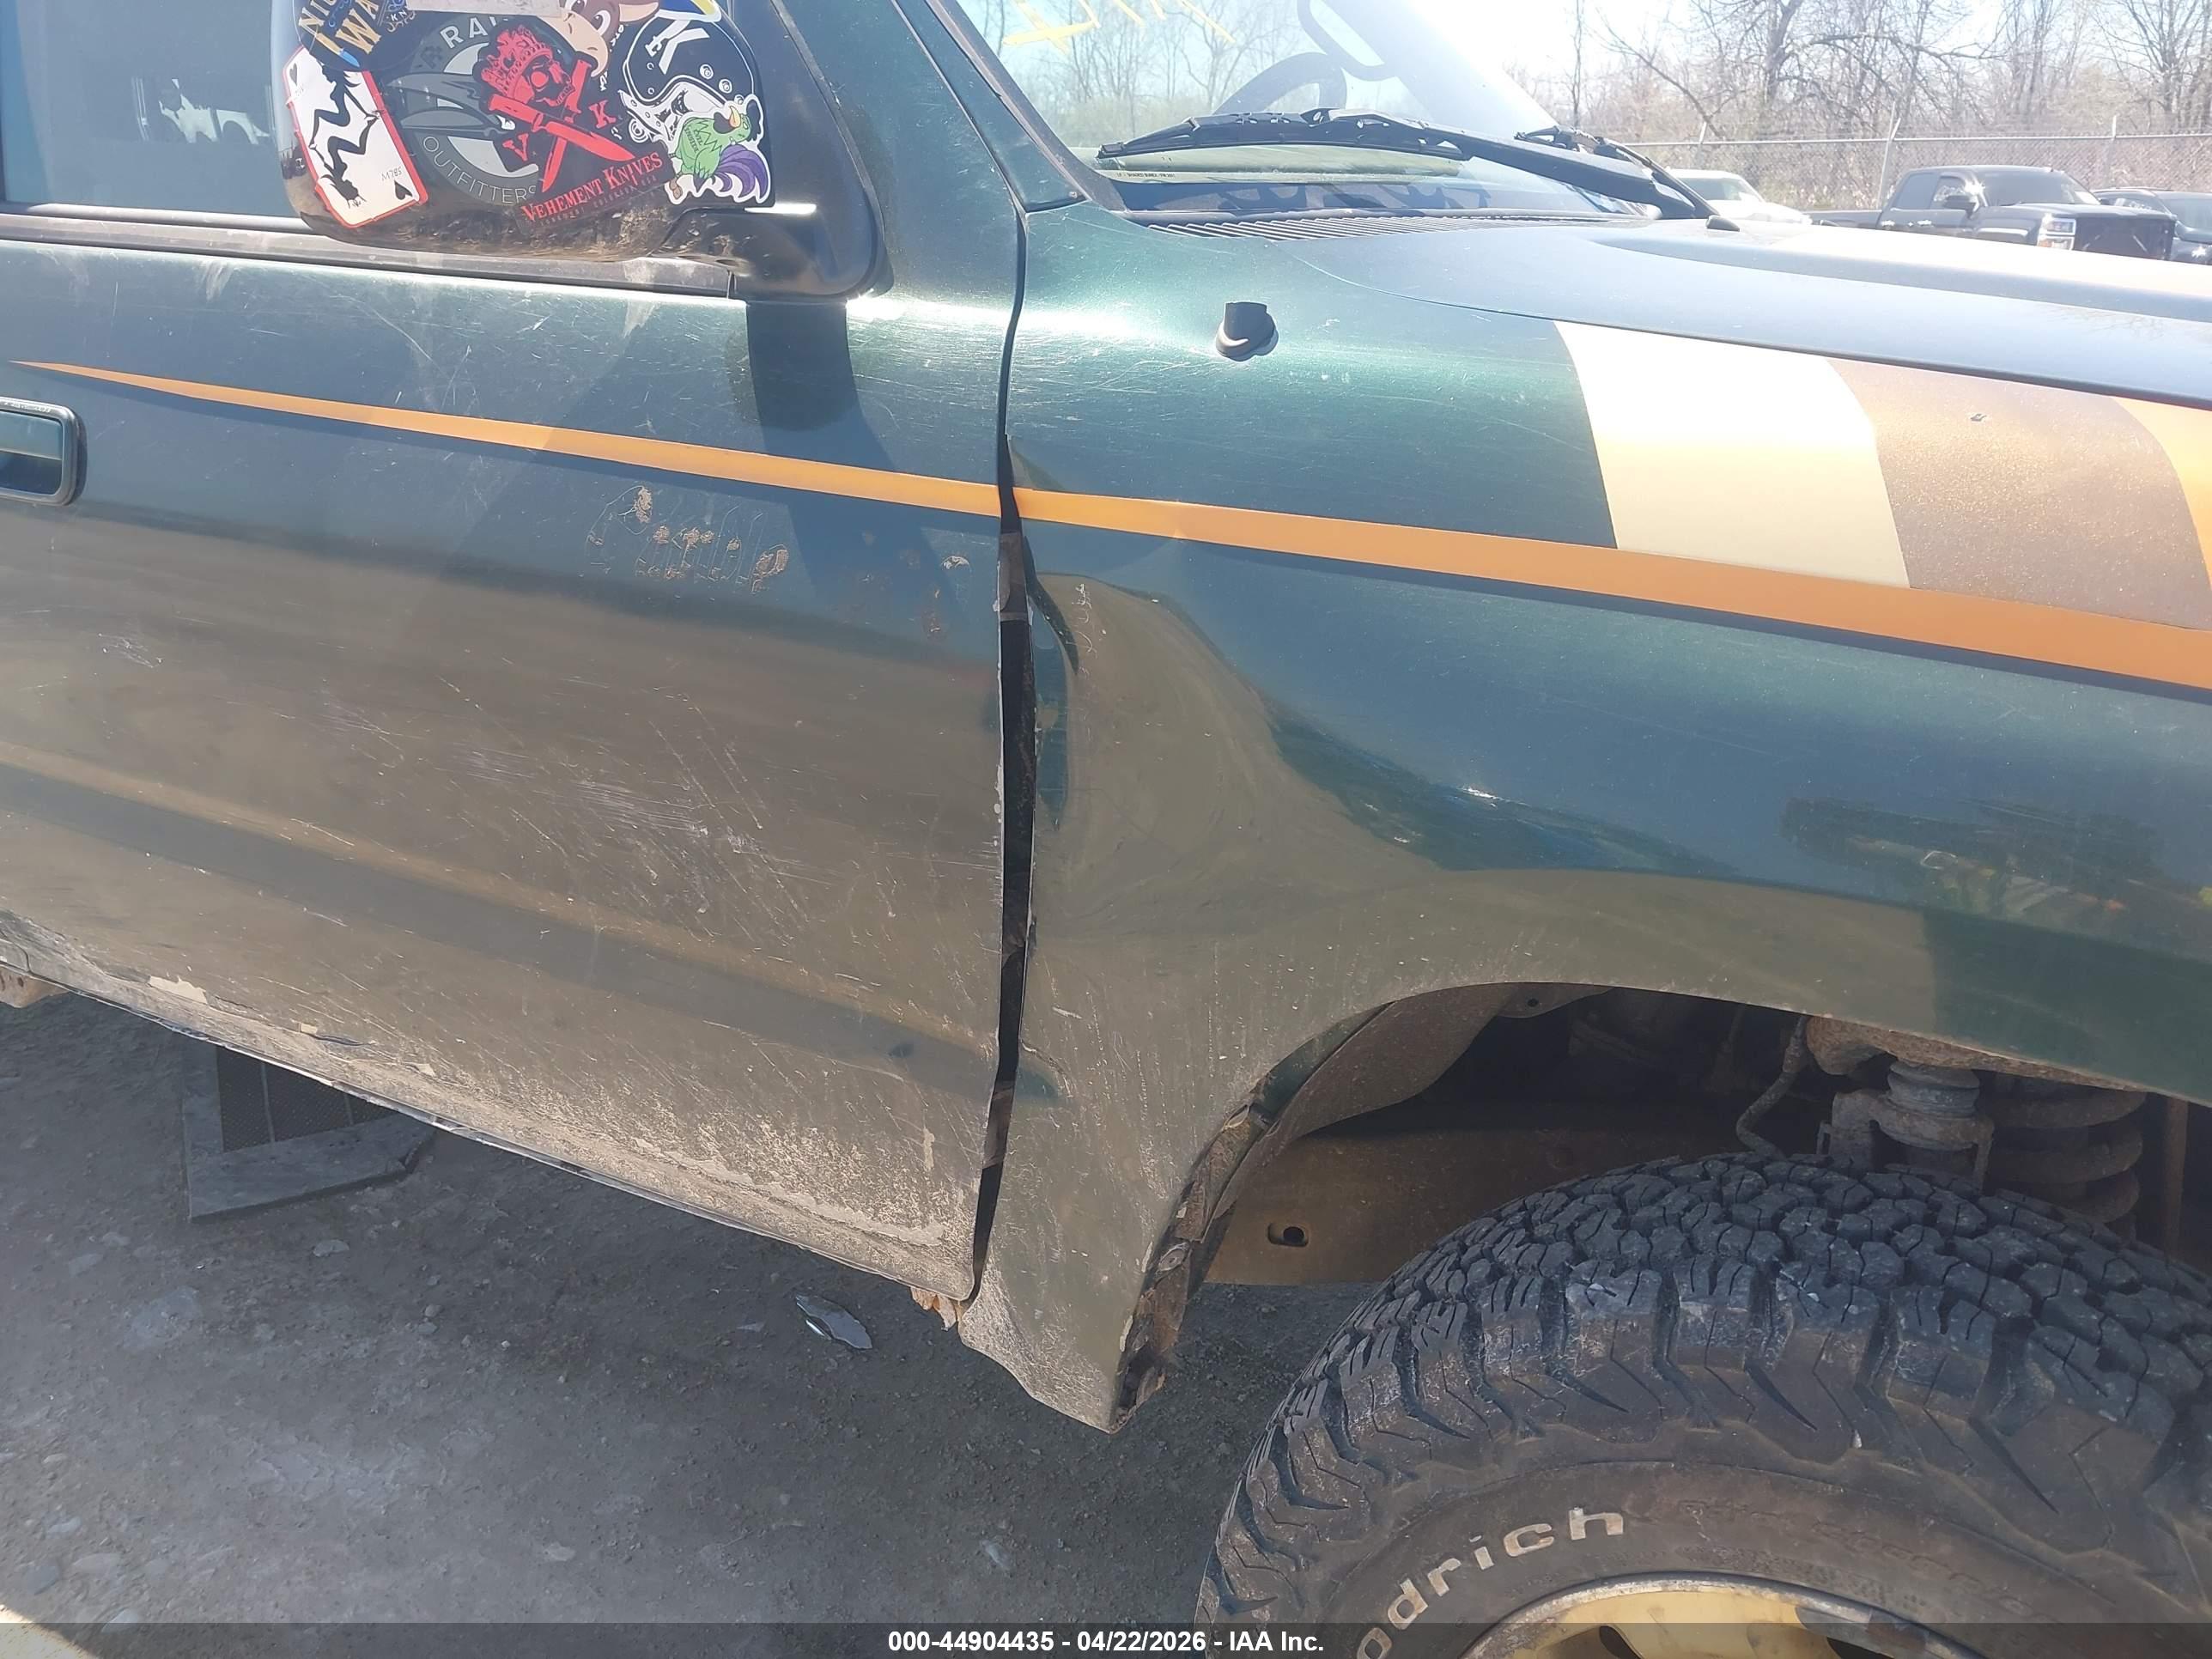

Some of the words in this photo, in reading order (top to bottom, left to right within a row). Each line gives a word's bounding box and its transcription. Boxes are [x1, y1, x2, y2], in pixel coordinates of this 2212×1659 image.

[502, 133, 529, 161] V
[589, 100, 617, 129] K
[521, 178, 604, 222] VEHEMENT
[603, 151, 663, 189] KNIVES
